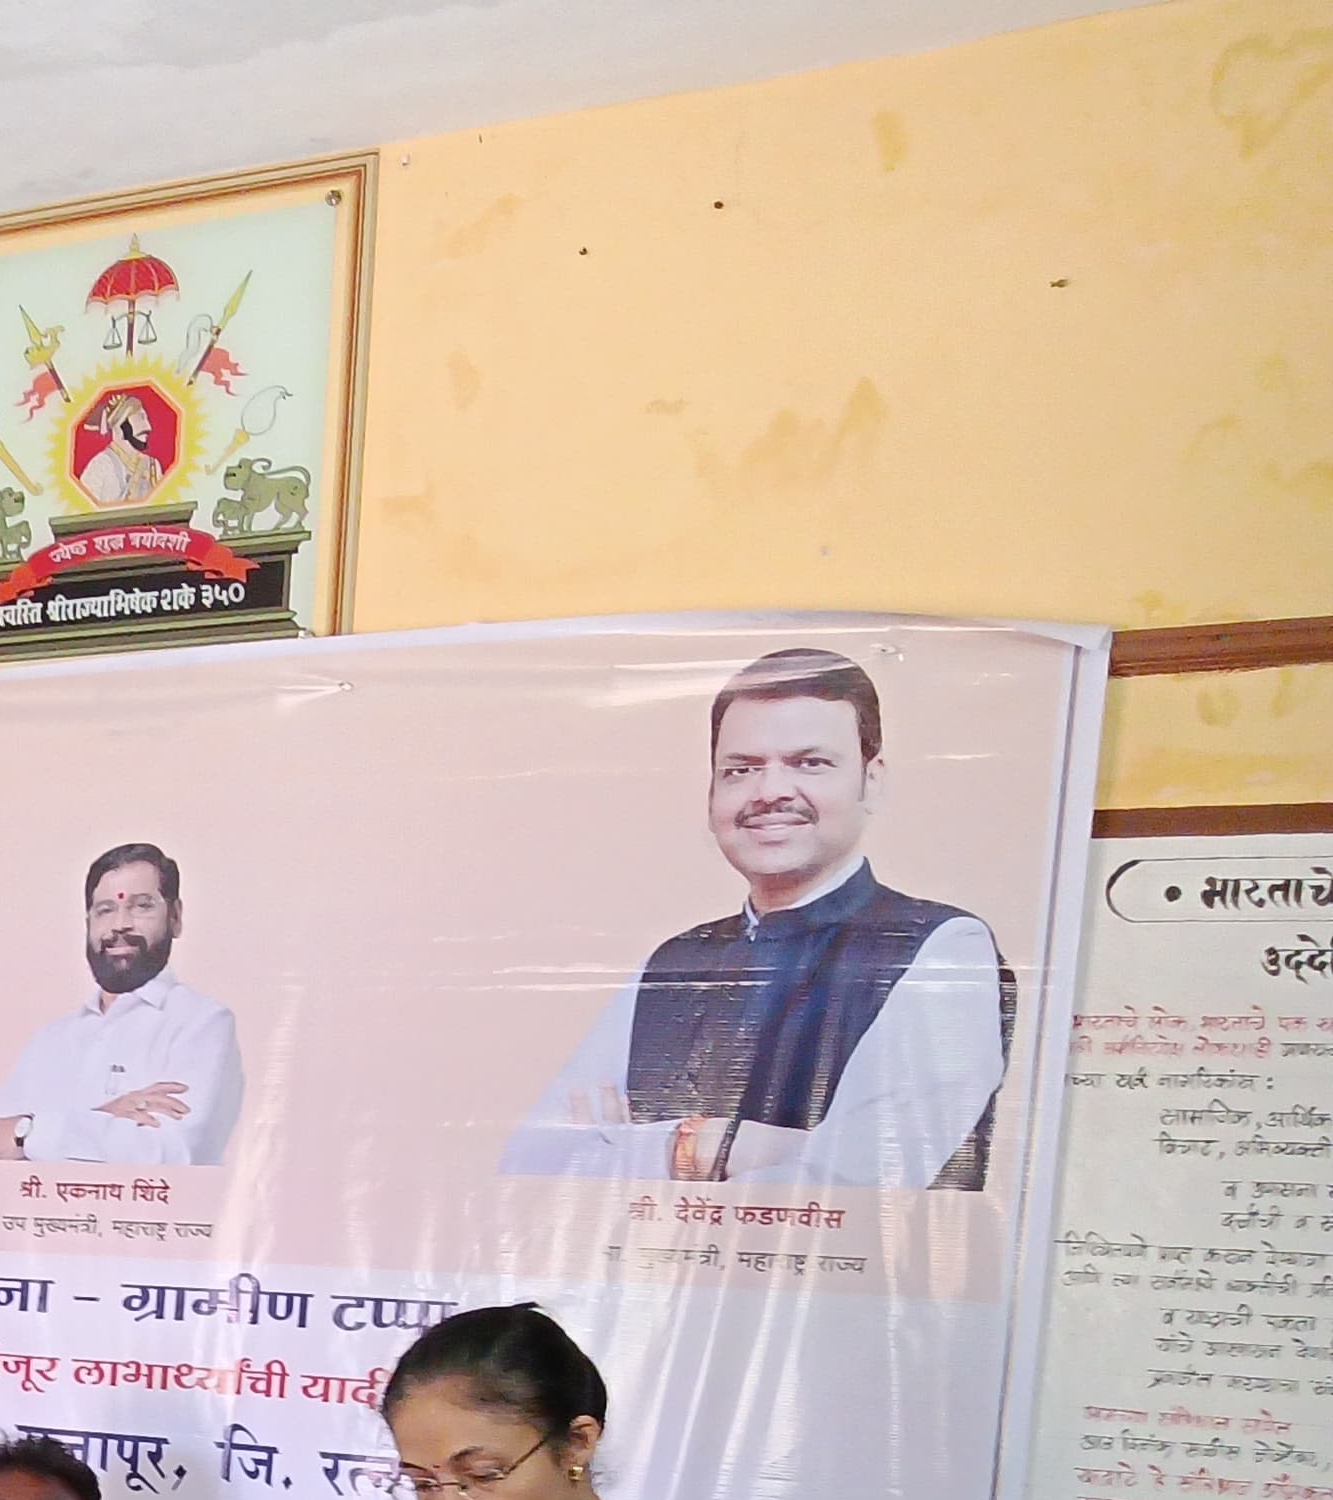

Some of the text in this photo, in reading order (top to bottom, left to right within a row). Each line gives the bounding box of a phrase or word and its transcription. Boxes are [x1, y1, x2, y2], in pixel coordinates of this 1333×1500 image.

[46, 587, 160, 623] श्रीराज्याभिषेक
[160, 582, 197, 611] शके
[200, 581, 246, 609] ३५०
[1200, 866, 1333, 910] भारताचे
[1261, 934, 1333, 984] उद्दे
[19, 1174, 172, 1204] श्री. एकनाथ शिंदे
[174, 1222, 214, 1240] राज्य
[674, 1196, 726, 1227] देवेंद्र
[121, 1272, 316, 1328] ग्रामीण
[213, 1422, 294, 1491] जि.
